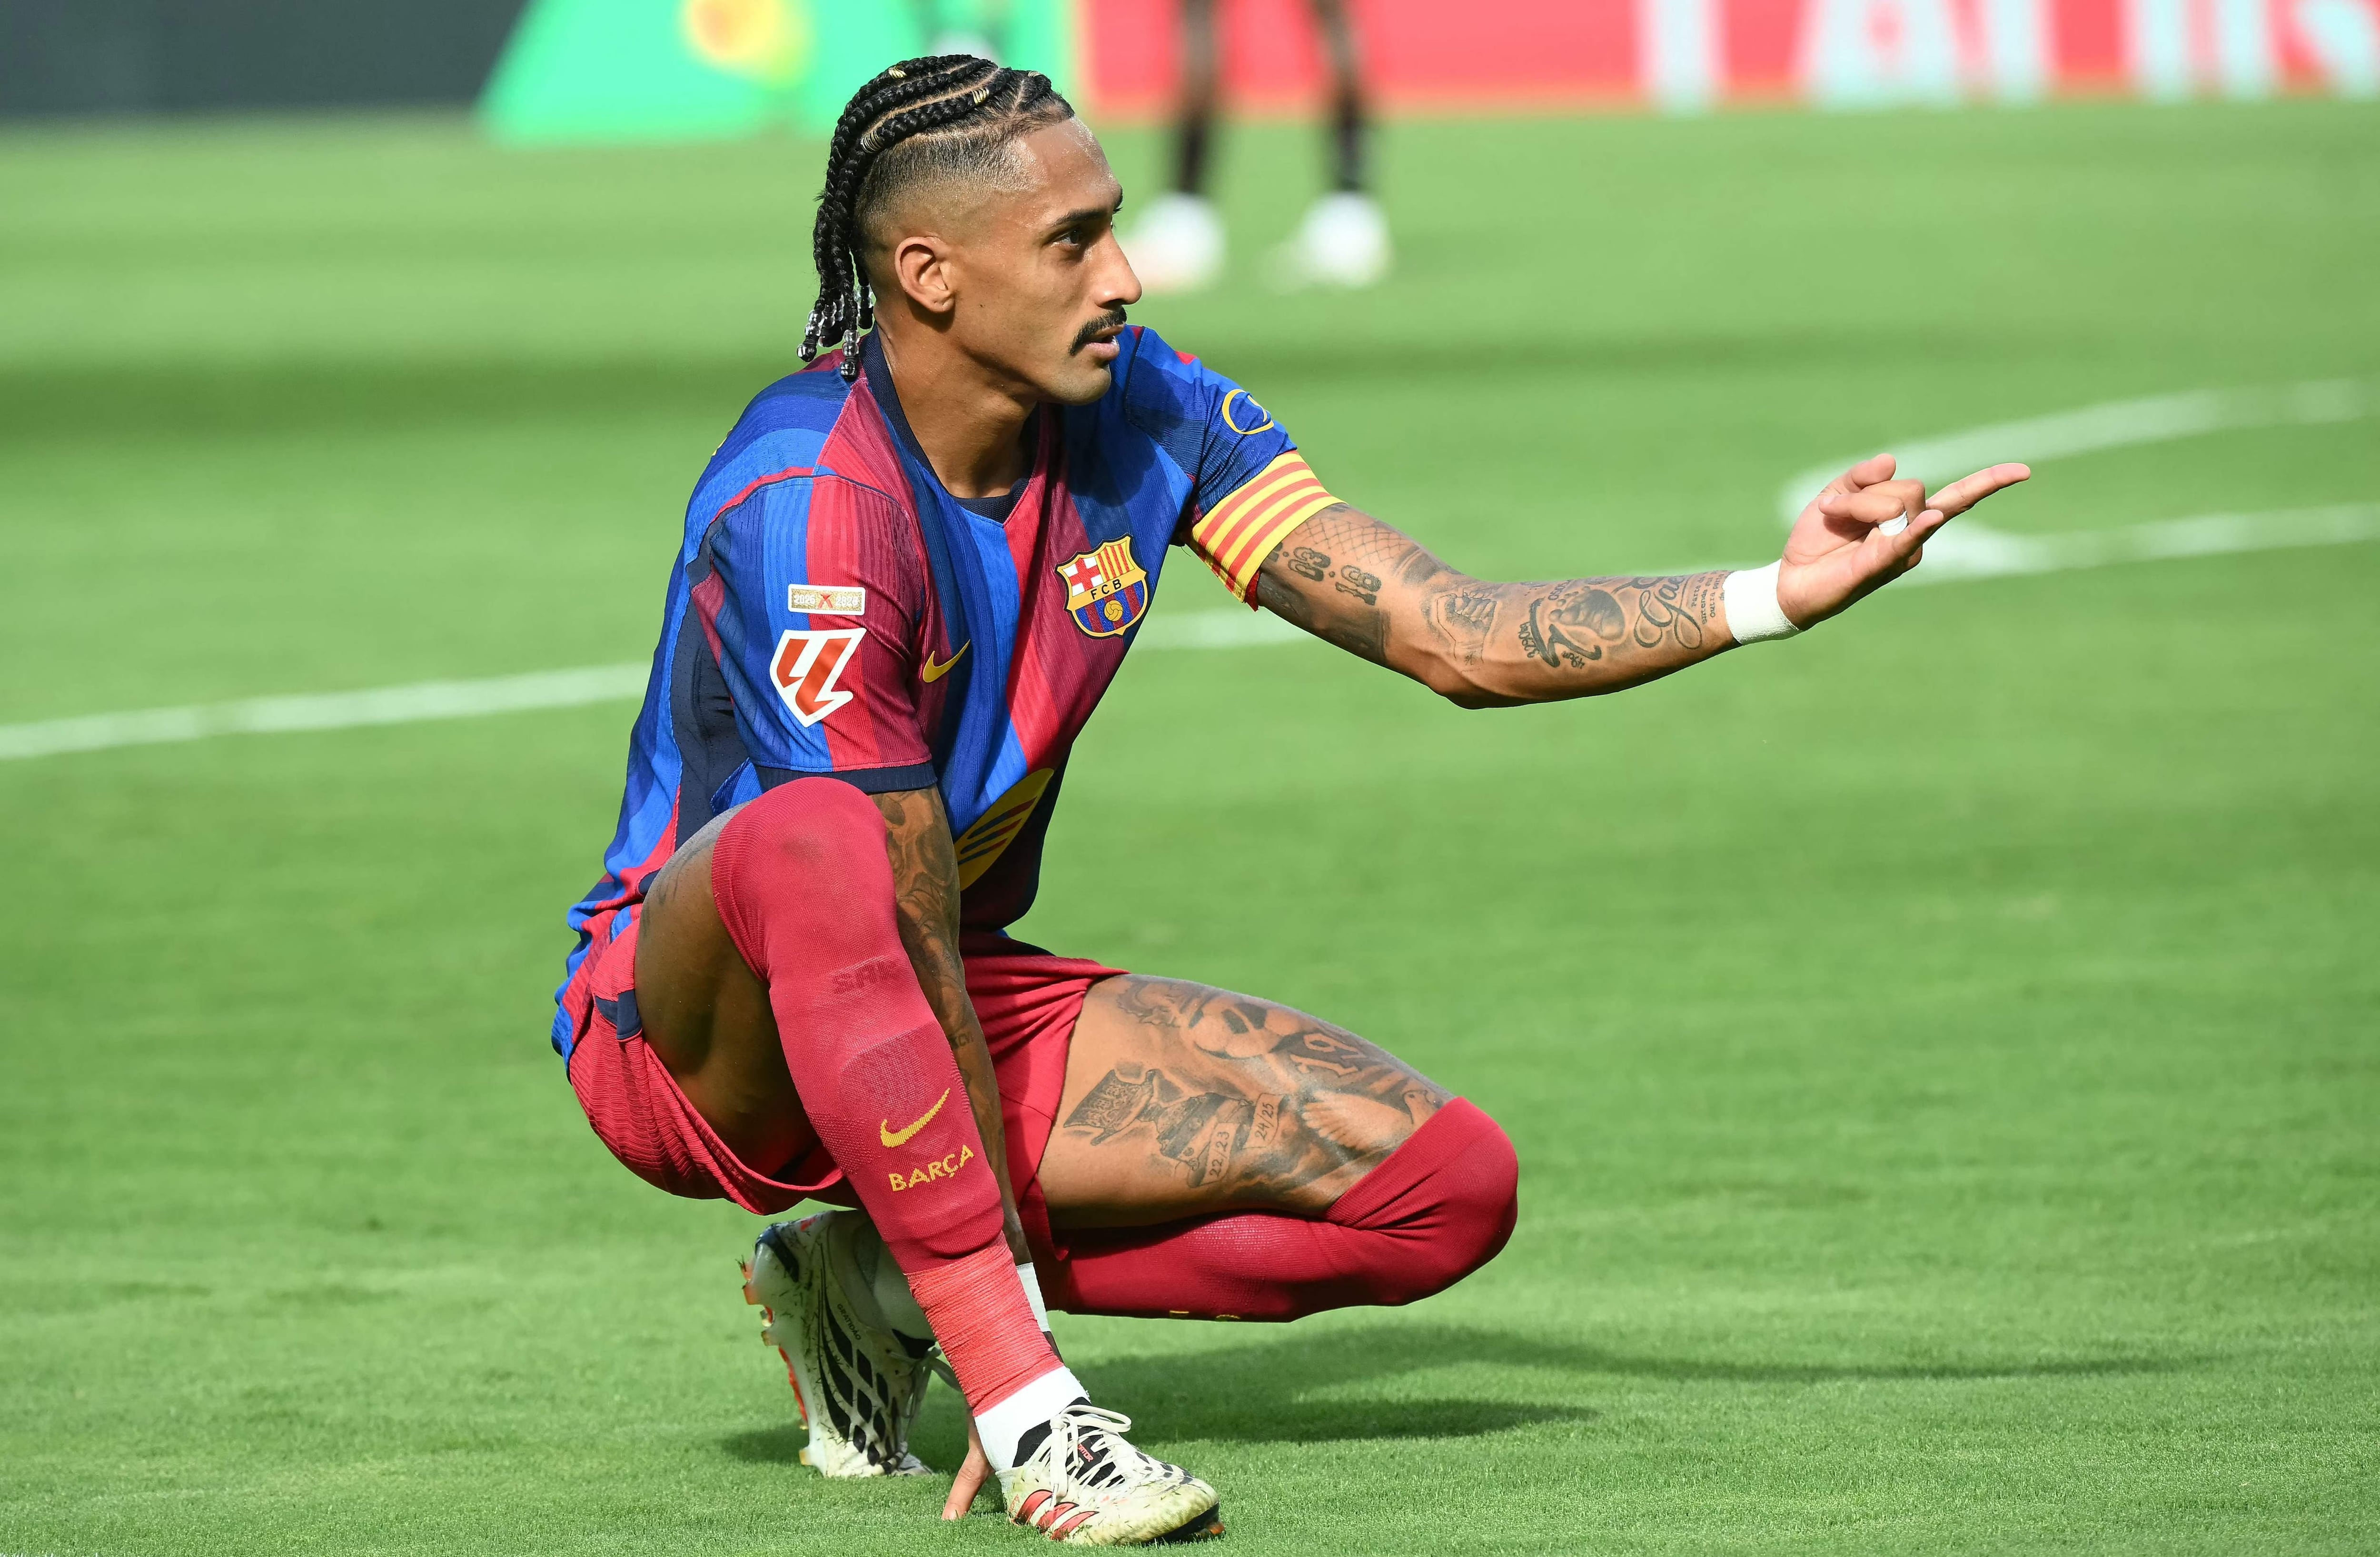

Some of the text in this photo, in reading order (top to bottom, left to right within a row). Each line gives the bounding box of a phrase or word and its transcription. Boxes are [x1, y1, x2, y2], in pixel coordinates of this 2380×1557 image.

[1090, 579, 1122, 600] FCB
[1254, 1102, 1276, 1141] 24/25
[888, 1144, 975, 1192] BARÇA
[1209, 1129, 1231, 1178] 22/23
[837, 1303, 862, 1340] GRATIDÃO
